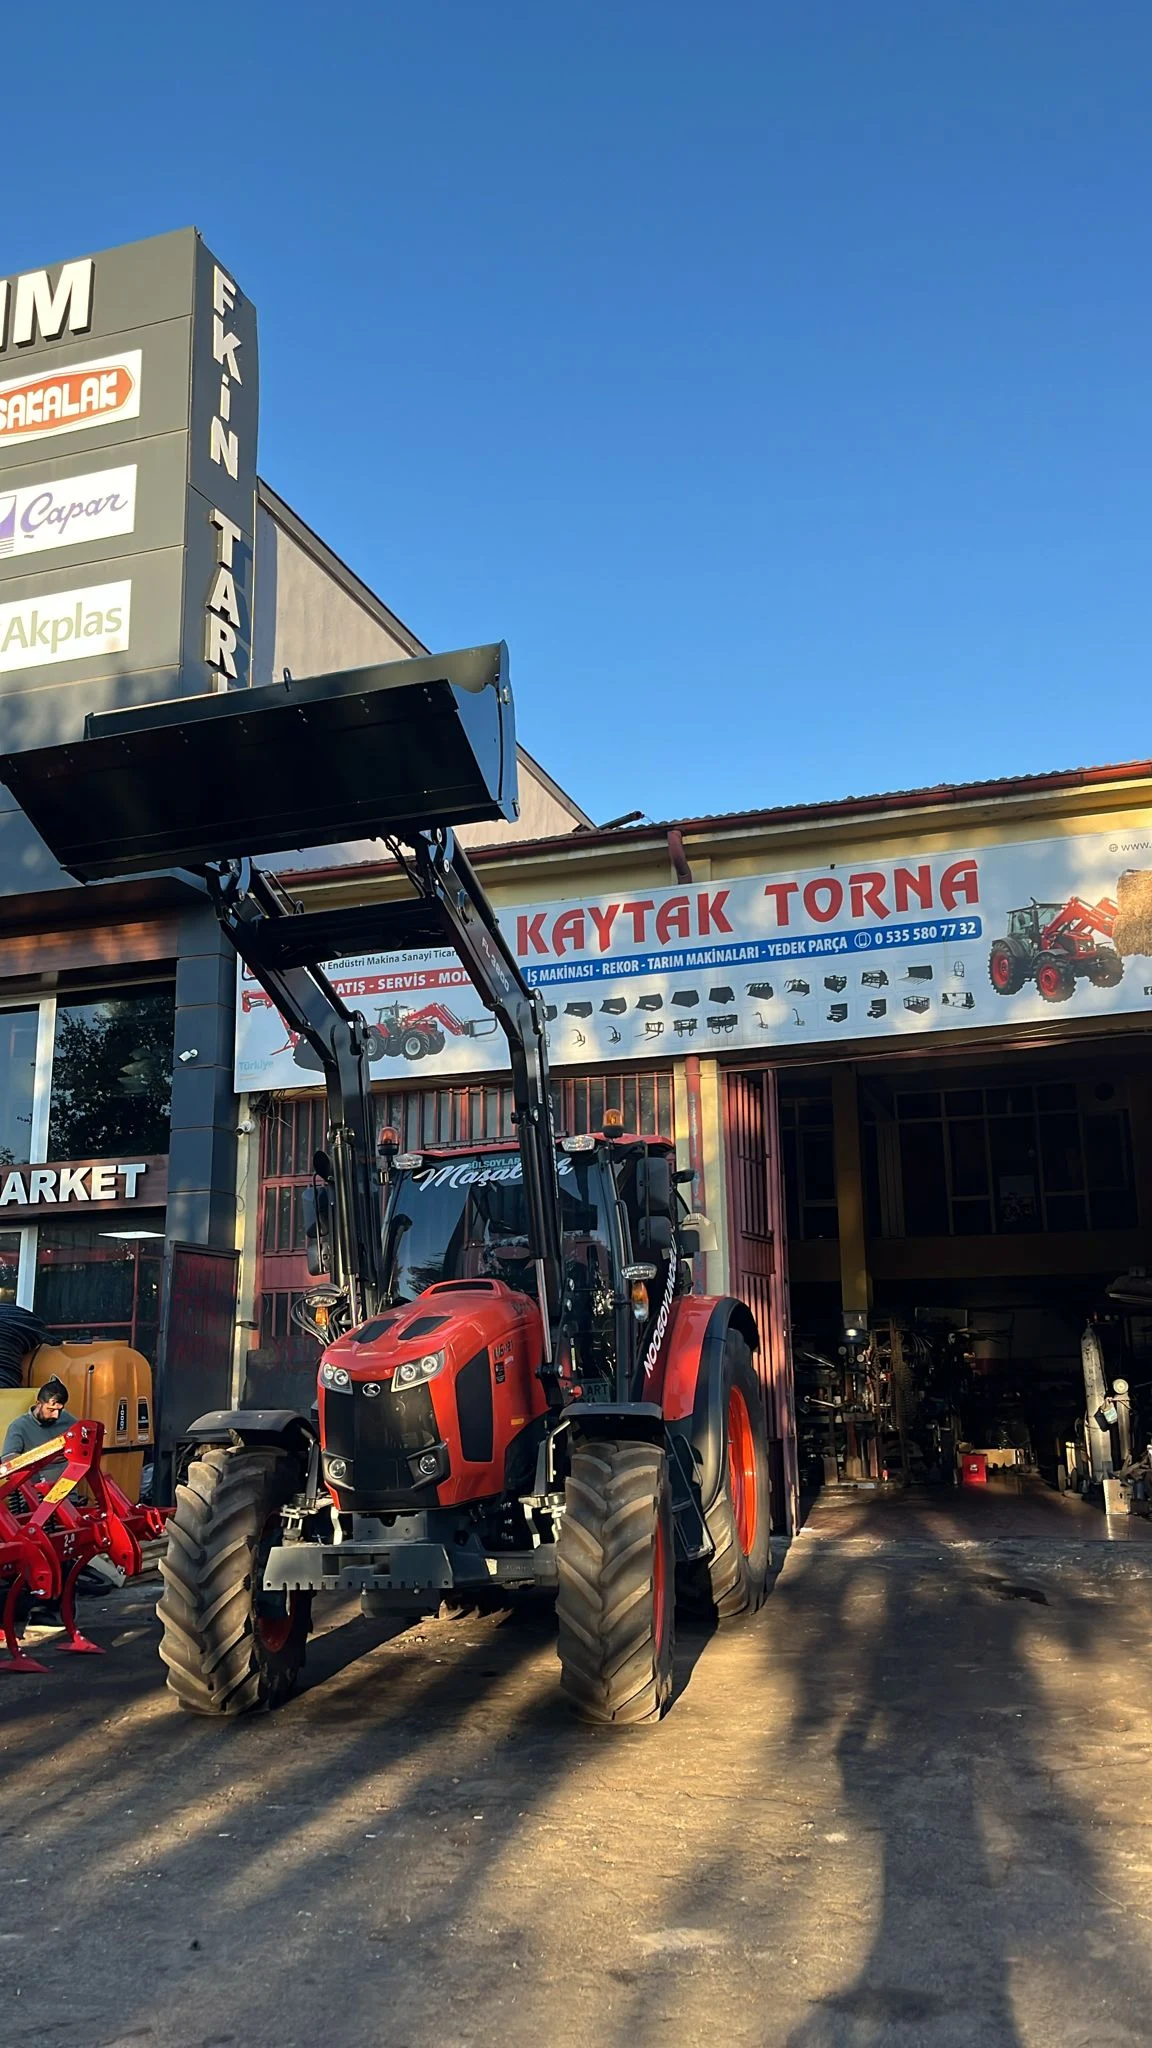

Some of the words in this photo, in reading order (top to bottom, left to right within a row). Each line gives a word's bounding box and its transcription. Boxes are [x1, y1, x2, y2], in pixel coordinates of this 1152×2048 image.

[2, 601, 123, 654] Akplas
[517, 889, 734, 958] KAYTAK
[764, 859, 979, 927] TORNA
[327, 958, 365, 970] Endüstri
[366, 955, 400, 966] Makina
[401, 950, 432, 964] Sanayi
[433, 949, 457, 959] Ticar
[527, 969, 538, 985] İŞ
[539, 964, 594, 982] MAKİNASI
[602, 959, 639, 975] REKOR
[647, 953, 684, 970] TARIM
[686, 946, 759, 967] MAKİNALARI
[768, 941, 806, 957] YEDEK
[808, 936, 848, 953] PARÇA
[874, 932, 883, 945] 0
[886, 929, 910, 944] 535
[913, 925, 937, 940] 580
[940, 923, 957, 937] 77
[959, 921, 977, 935] 32
[332, 980, 366, 995] ATIŞ
[377, 973, 426, 990] SERVİS
[438, 970, 472, 984] MON
[0, 1163, 146, 1206] ARKET
